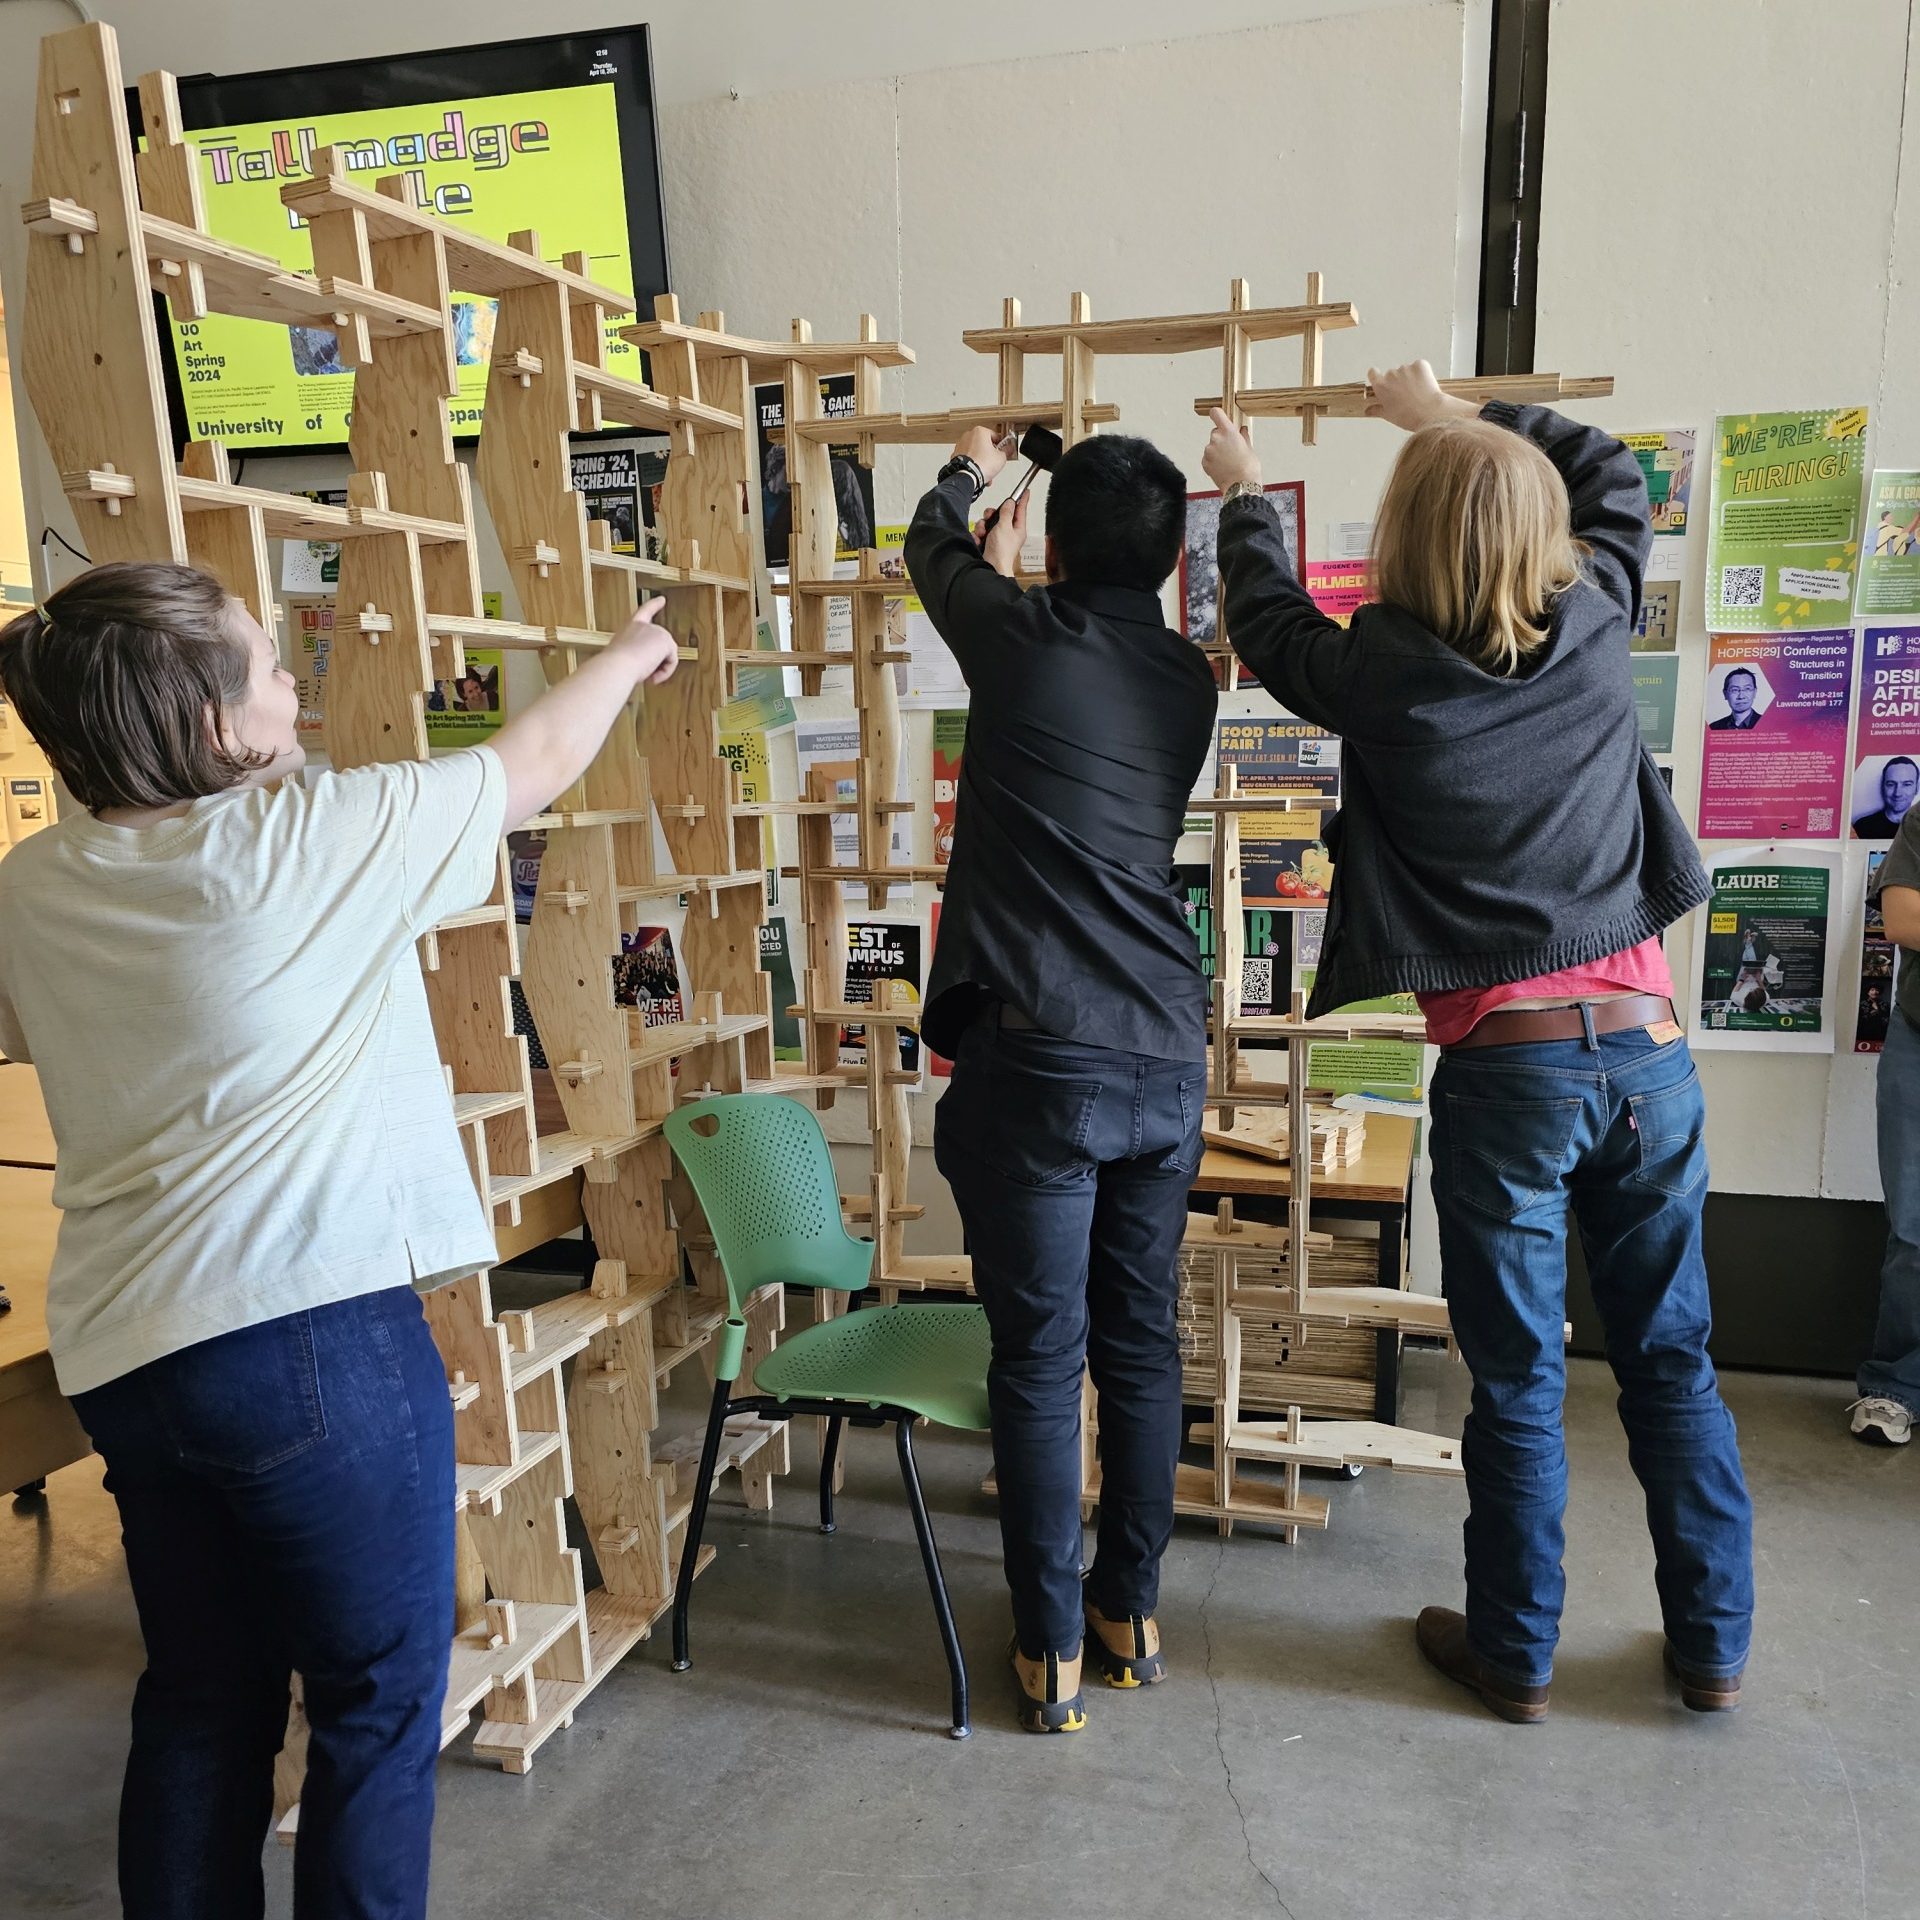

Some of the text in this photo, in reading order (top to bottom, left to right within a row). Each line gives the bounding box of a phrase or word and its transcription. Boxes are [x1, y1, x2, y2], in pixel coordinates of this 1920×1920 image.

[180, 323, 200, 336] UO
[183, 340, 203, 352] Art
[185, 353, 225, 369] Spring
[188, 369, 221, 383] 2024
[828, 395, 856, 412] GAME
[761, 403, 782, 419] THE
[197, 416, 284, 437] University
[305, 413, 323, 431] of
[762, 418, 773, 427] THE
[1726, 420, 1815, 458] WE'RE
[1732, 451, 1850, 495] HIRING!
[573, 470, 637, 492] SCHEDULE
[1879, 486, 1895, 499] ASK
[1904, 485, 1920, 499] GRA
[1307, 574, 1368, 590] FILMED
[1717, 645, 1848, 659] HOPES[29] Conference
[1789, 659, 1845, 669] Structures in
[1800, 671, 1843, 680] Transition
[1797, 692, 1815, 700] April
[1776, 700, 1811, 708] Lawrence
[1829, 699, 1843, 707] 177
[1221, 726, 1265, 738] FOOD
[1901, 721, 1920, 729] Satur
[719, 744, 744, 758] ARE
[1220, 738, 1255, 750] FAIR
[1238, 754, 1253, 763] LIVE
[1300, 753, 1319, 762] SNAP
[1716, 874, 1780, 889] LAURE
[760, 927, 780, 942] OU
[847, 926, 889, 949] EST
[760, 942, 782, 951] CTED
[847, 948, 905, 966] AMPUS
[861, 965, 893, 973] EVENT
[638, 998, 680, 1012] WE'RE
[644, 1012, 681, 1027] RING!
